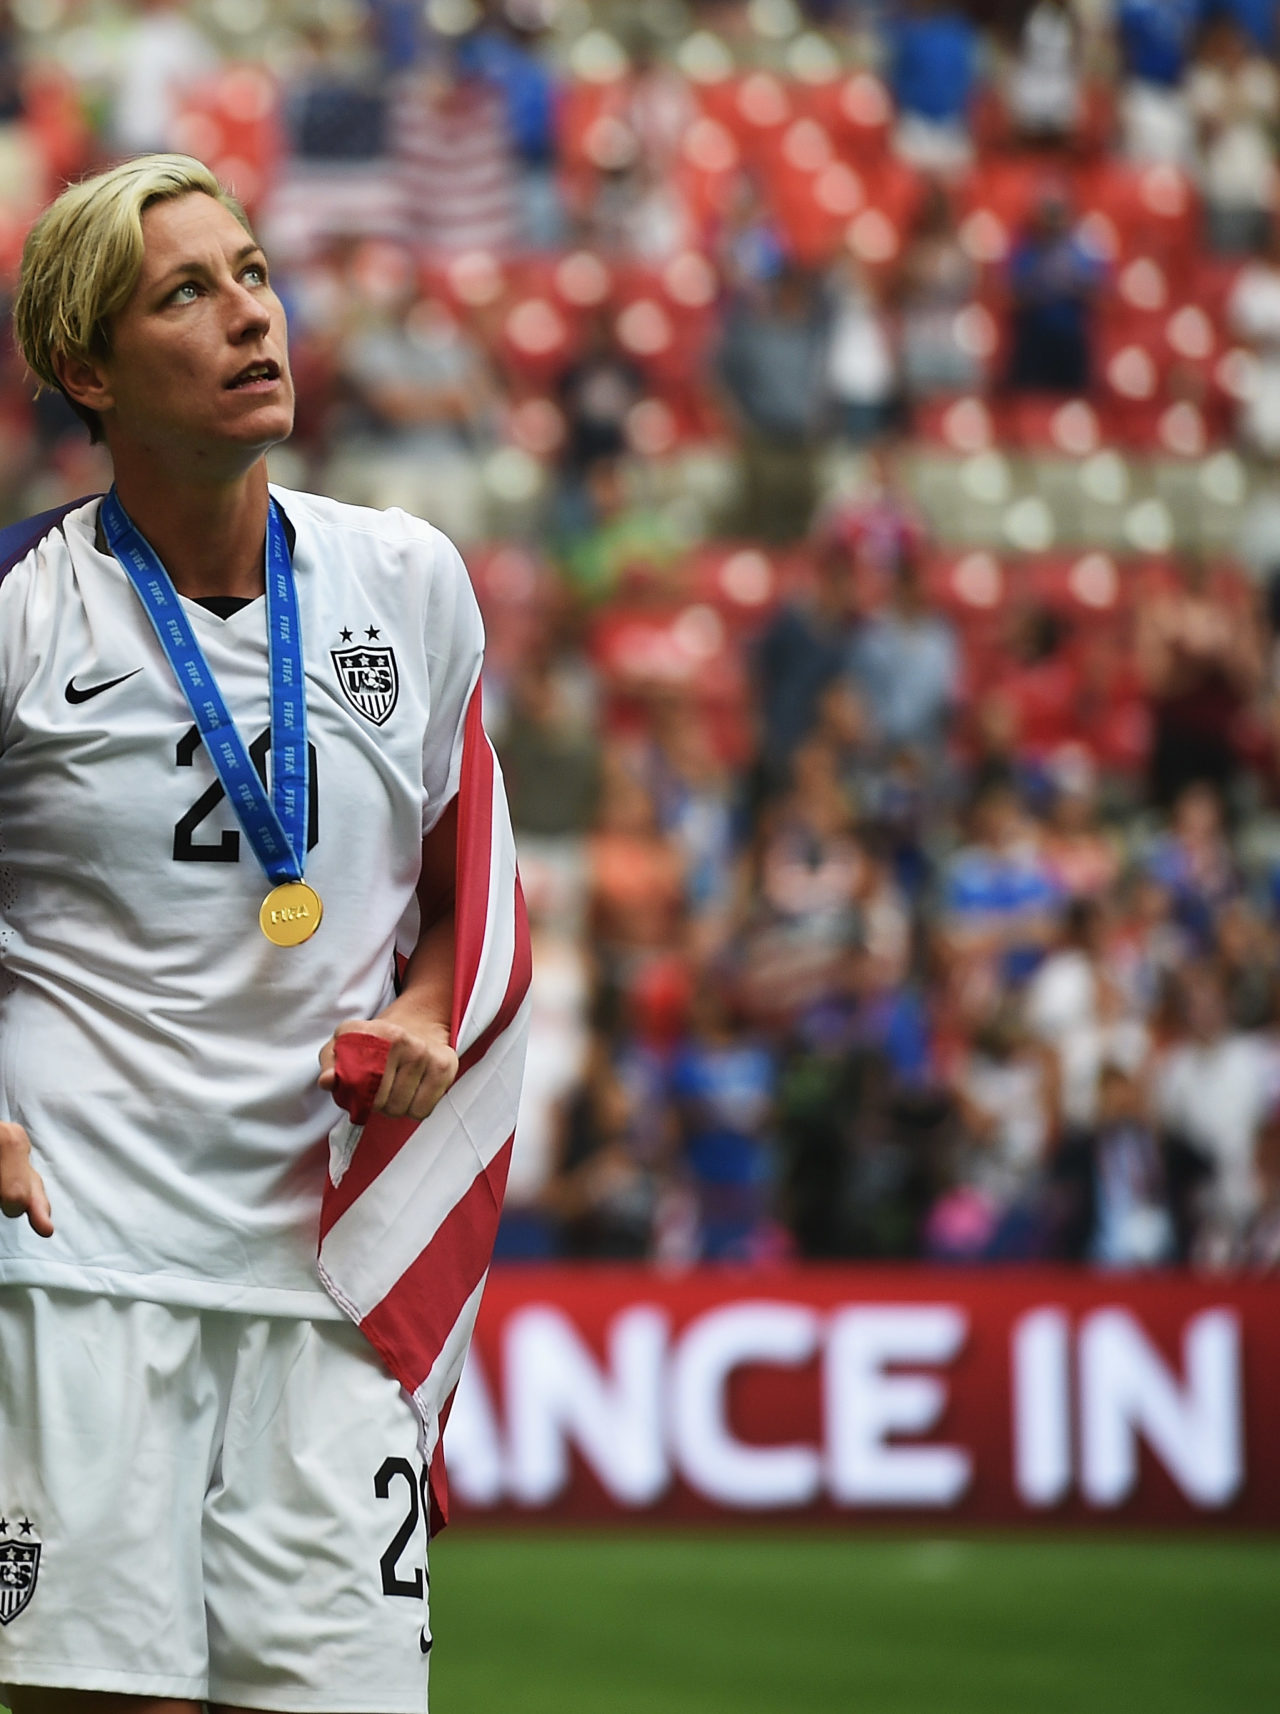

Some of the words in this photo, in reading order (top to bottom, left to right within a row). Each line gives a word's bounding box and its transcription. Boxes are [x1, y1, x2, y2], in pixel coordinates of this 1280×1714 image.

[277, 573, 287, 599] FIFA
[280, 615, 290, 641] FIFA
[282, 657, 293, 684] FIFA
[129, 548, 147, 571] FIFA
[148, 580, 166, 605] FIFA
[167, 619, 184, 646] FIFA
[184, 660, 202, 687] FIFA
[203, 701, 220, 728] FIFA
[220, 742, 238, 768] FIFA
[238, 783, 256, 811] FIFA
[259, 826, 276, 853] FIFA
[283, 701, 294, 728] FIFA
[284, 746, 294, 773] FIFA
[284, 789, 295, 815] FIFA
[270, 904, 310, 925] FIFA
[1012, 1307, 1242, 1508] IN
